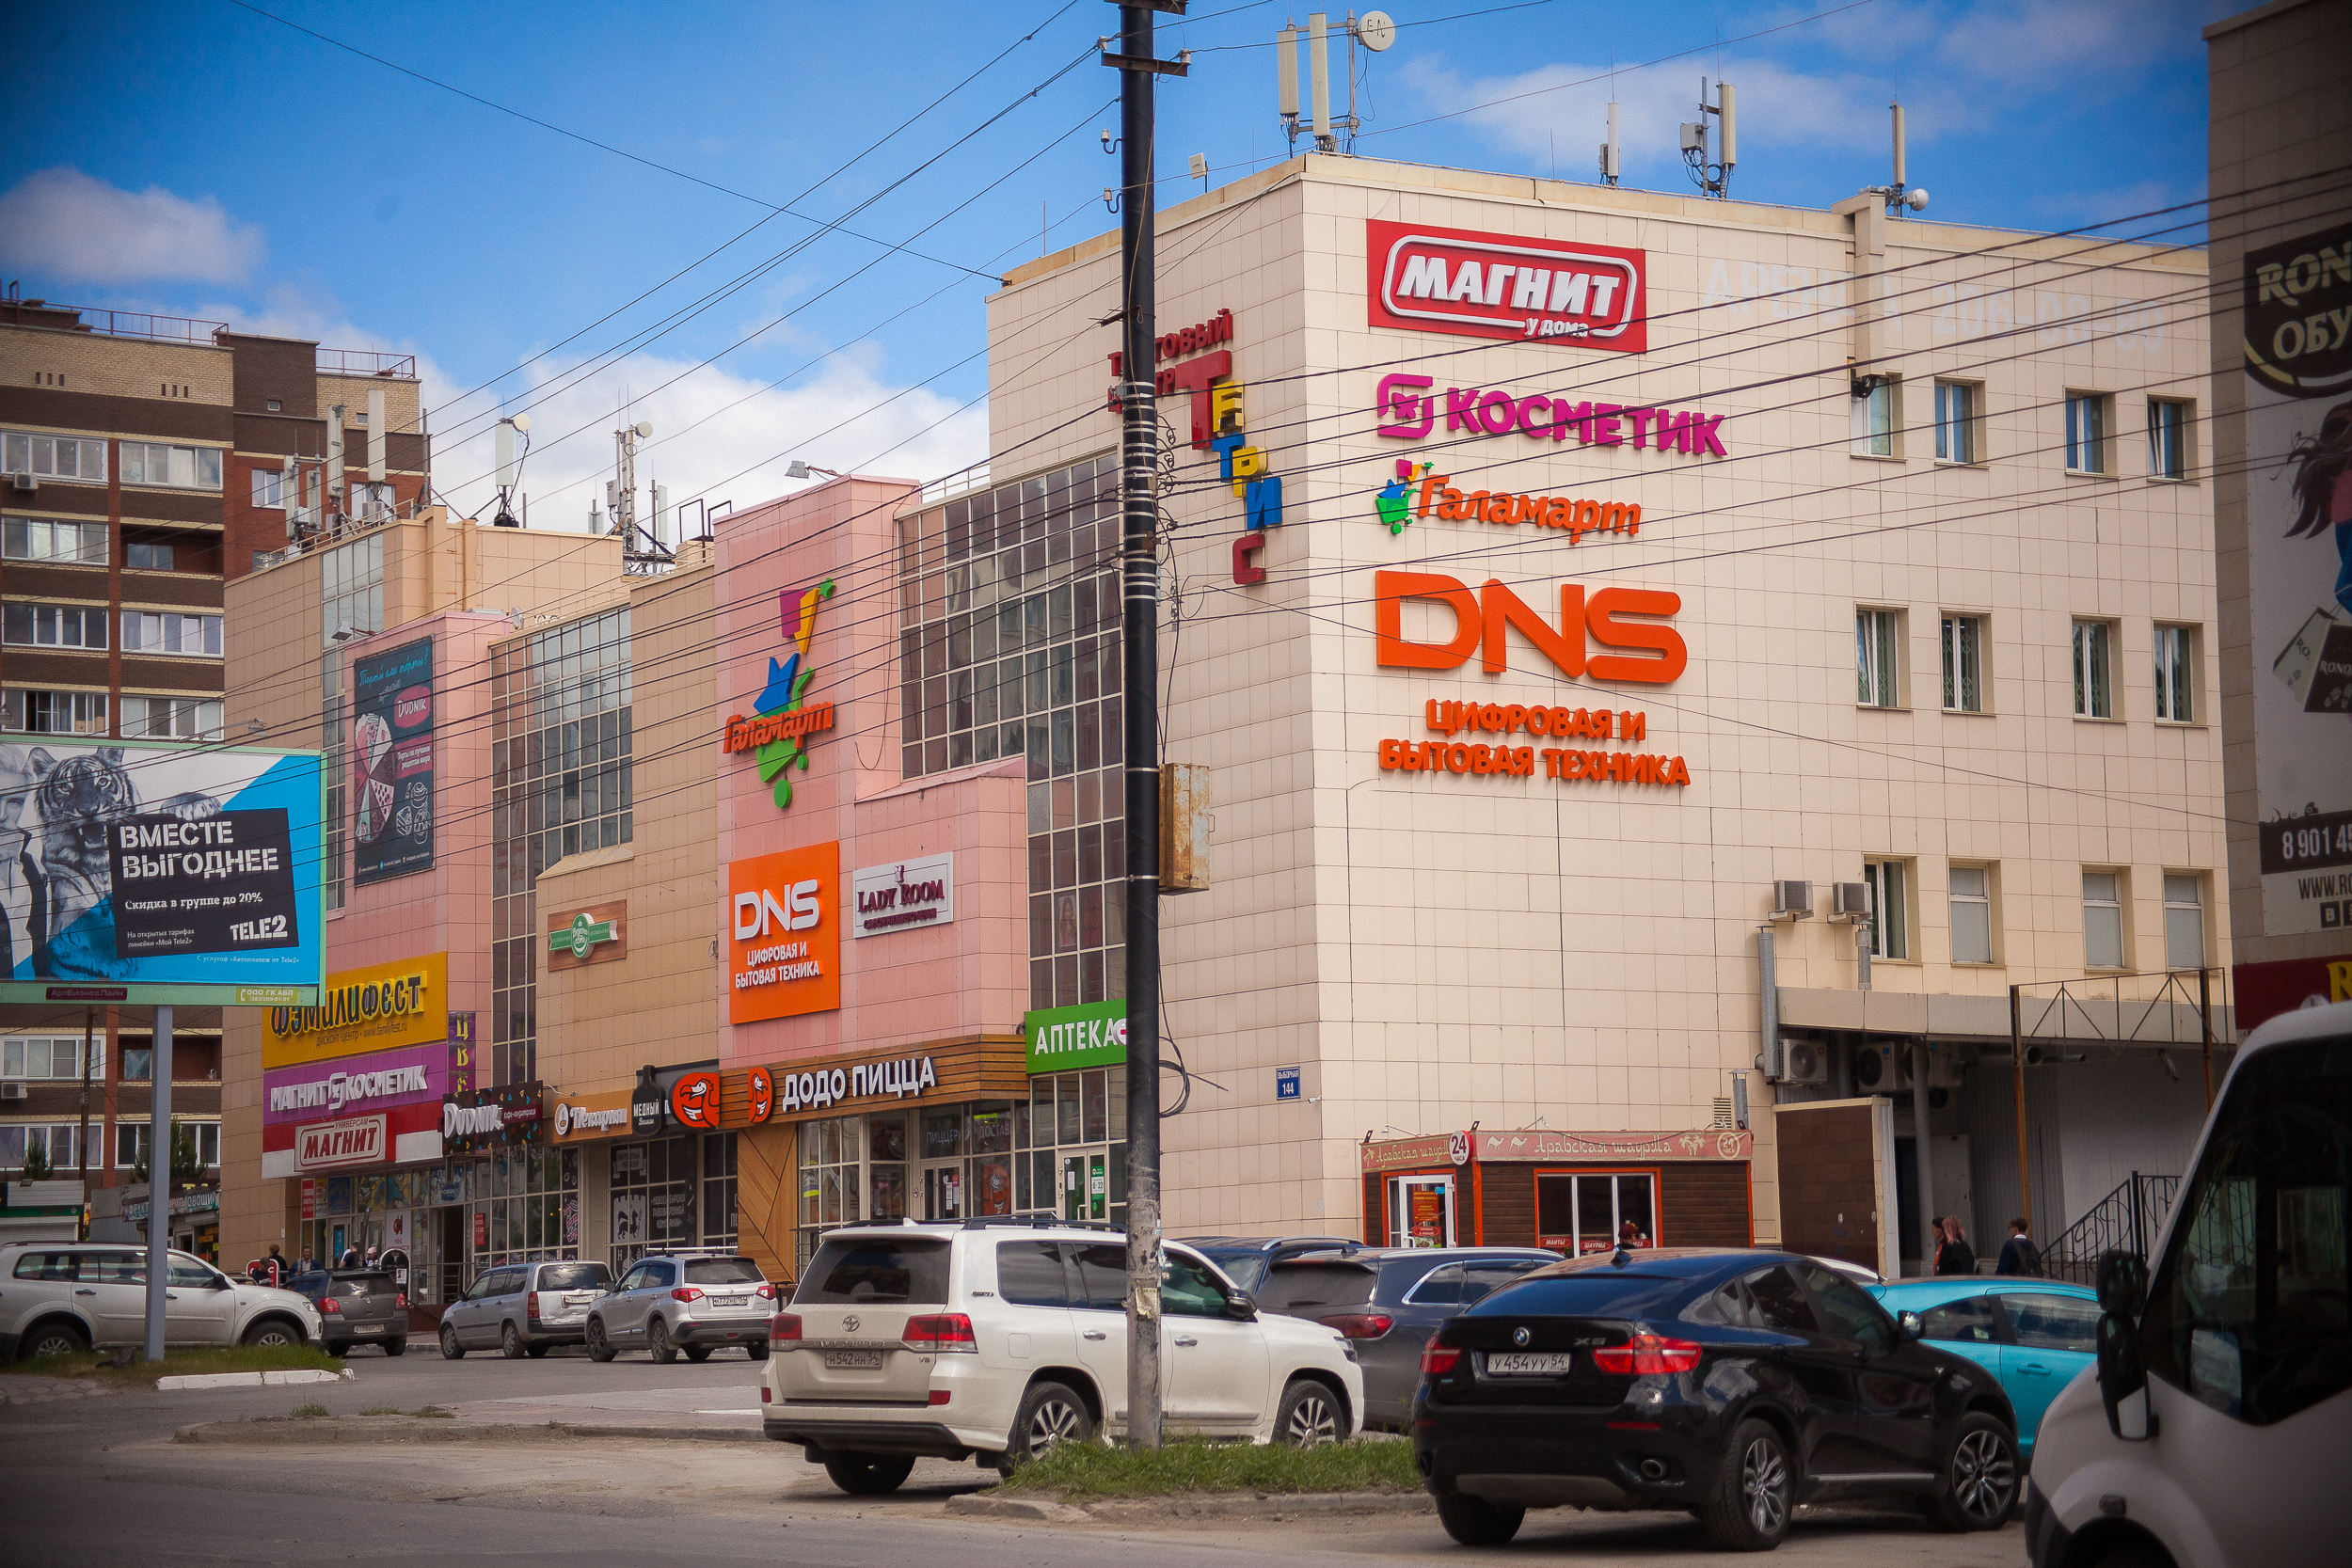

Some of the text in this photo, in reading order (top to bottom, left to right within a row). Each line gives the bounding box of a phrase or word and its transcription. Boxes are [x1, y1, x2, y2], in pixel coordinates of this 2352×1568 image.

[1396, 254, 1620, 317] МАГНИТ
[1540, 320, 1589, 338] дома
[1931, 283, 2164, 355] 206-08-80
[1107, 309, 1232, 377] ТГОВЫЙ
[1446, 387, 1728, 457] КОСМЕТИК
[1175, 350, 1281, 585] ТЕТРИС
[1417, 474, 1642, 545] Галамарт
[1375, 570, 1688, 684] DNS
[398, 698, 426, 719] DUDNIK
[1426, 698, 1645, 741] ЦИФРОВАЯ И
[723, 702, 833, 753] Галамарт
[1379, 738, 1691, 785] БЫТОВАЯ ТЕХНИКА
[119, 820, 233, 848] ВМЕСТЕ
[2282, 832, 2294, 860] 8
[2297, 827, 2330, 858] 901
[121, 847, 278, 879] ВЫГОДНЕЕ
[125, 893, 263, 910] Скидка в группе до 20%
[857, 879, 945, 912] LADY ROOM
[735, 879, 820, 941] DNS
[137, 929, 167, 939] открытых
[168, 928, 195, 938] тарифах
[230, 914, 288, 941] TELE2
[127, 940, 154, 948] линейки
[747, 942, 807, 967] ЦИФРОВАЯ И
[735, 960, 819, 989] БЫТОВАЯ ТЕХНИКА
[51, 989, 123, 997] АртБизнесЛайн
[1035, 1018, 1118, 1055] АПТЕКА
[271, 1065, 428, 1112] МАГНИТ КОСМЕТИК
[783, 1055, 938, 1112] ДОДО ПИЦЦА
[1282, 1082, 1295, 1095] 144
[443, 1102, 504, 1138] DUDNIK
[570, 1107, 628, 1131] Пекарня
[633, 1099, 660, 1117] МЕДНЫЙ
[334, 1117, 369, 1130] УНИВЕРСАМ
[927, 1130, 963, 1145] ПИЦЦЕРИ
[303, 1127, 377, 1160] МАГНИТ
[1375, 1139, 1450, 1167] Арабская шаурм
[1451, 1134, 1467, 1155] 24
[1534, 1133, 1608, 1160] Арабская
[1723, 1138, 1734, 1148] 24
[187, 1192, 214, 1208] ОВОЩИ
[1551, 1354, 1565, 1366] 54
